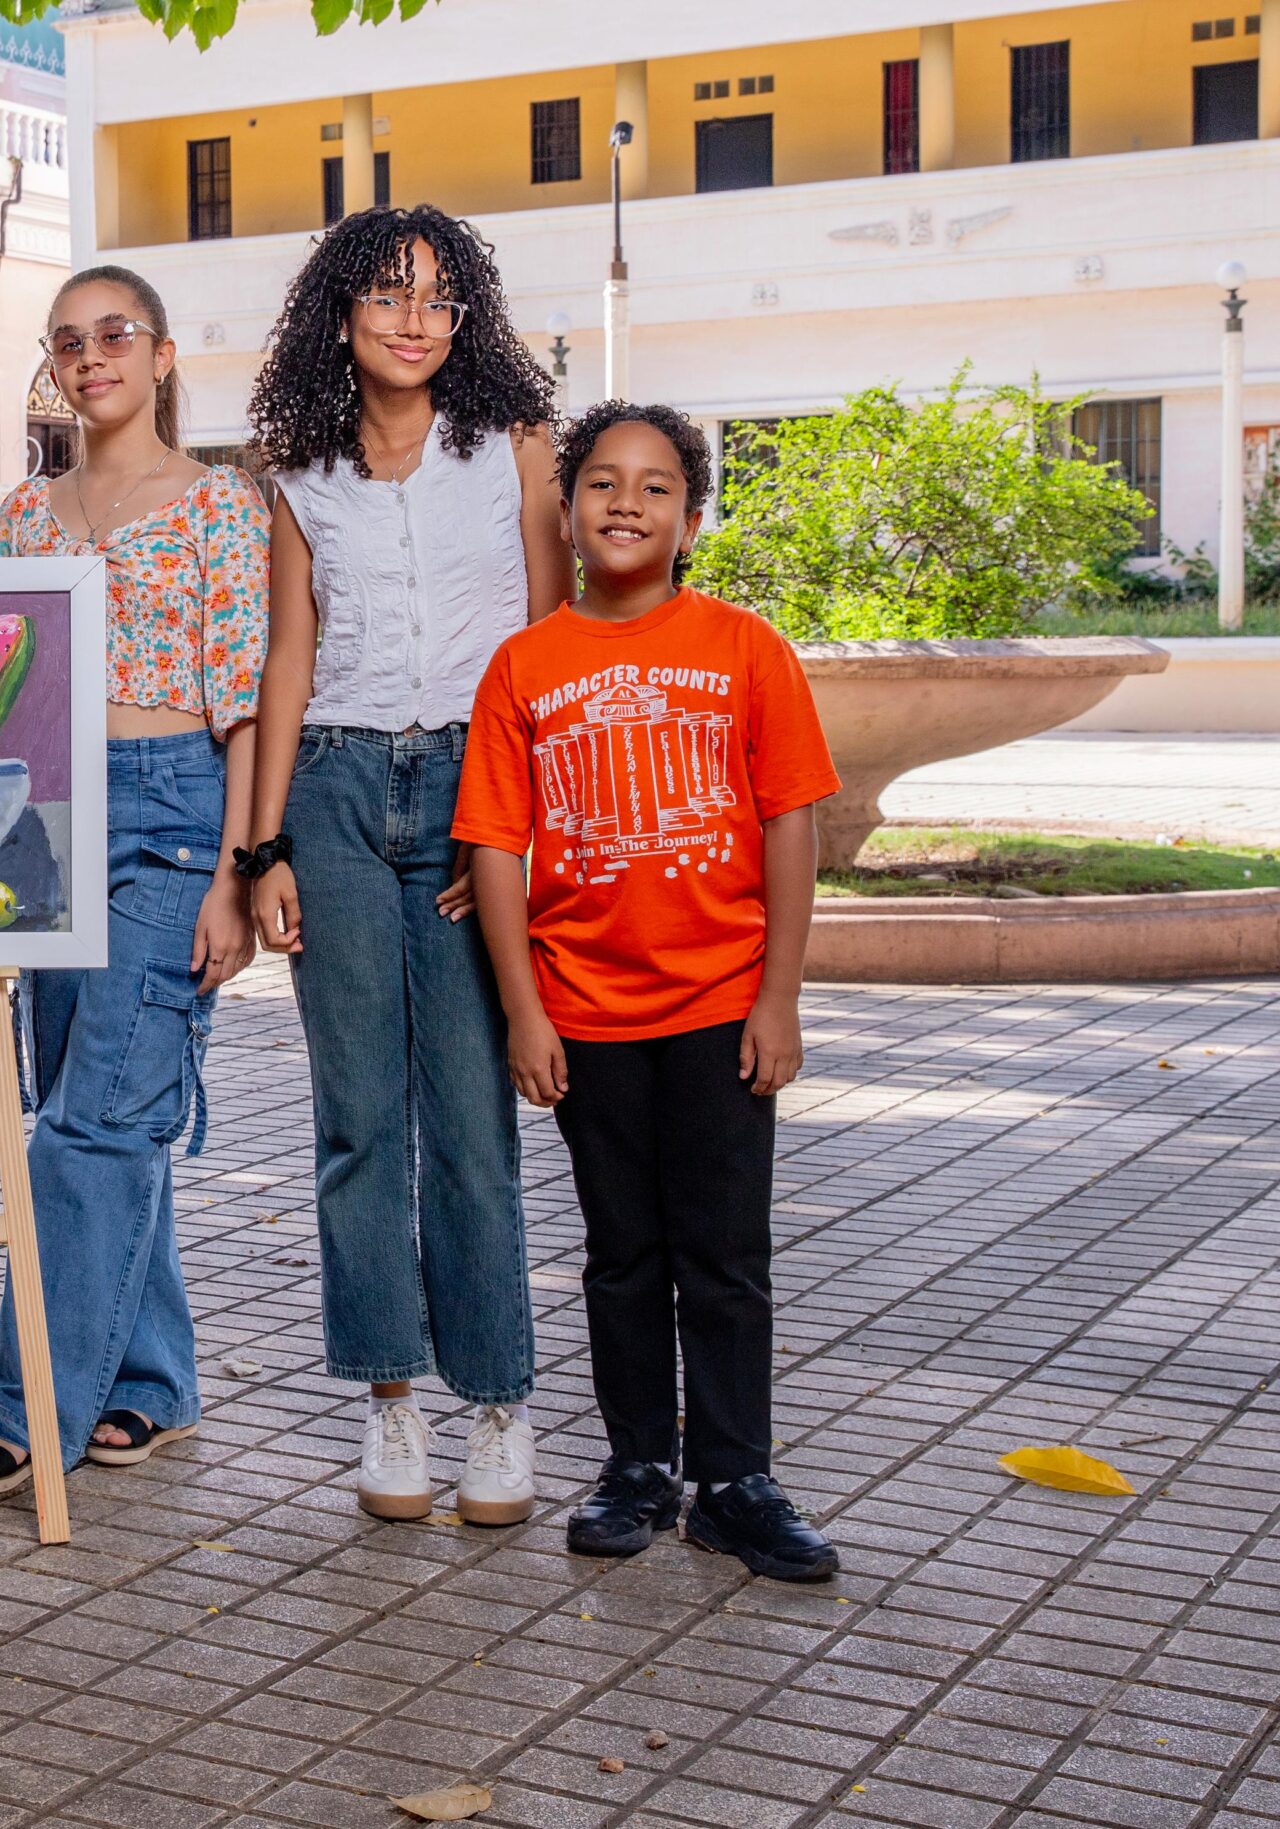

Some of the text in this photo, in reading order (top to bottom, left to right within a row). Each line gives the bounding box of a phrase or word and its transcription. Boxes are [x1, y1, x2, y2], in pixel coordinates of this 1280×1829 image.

[647, 667, 732, 697] COUNTS
[659, 730, 676, 795] Fairness
[710, 727, 721, 784] Caring
[576, 845, 595, 859] Join
[619, 840, 648, 852] The
[655, 831, 718, 849] Journey!
